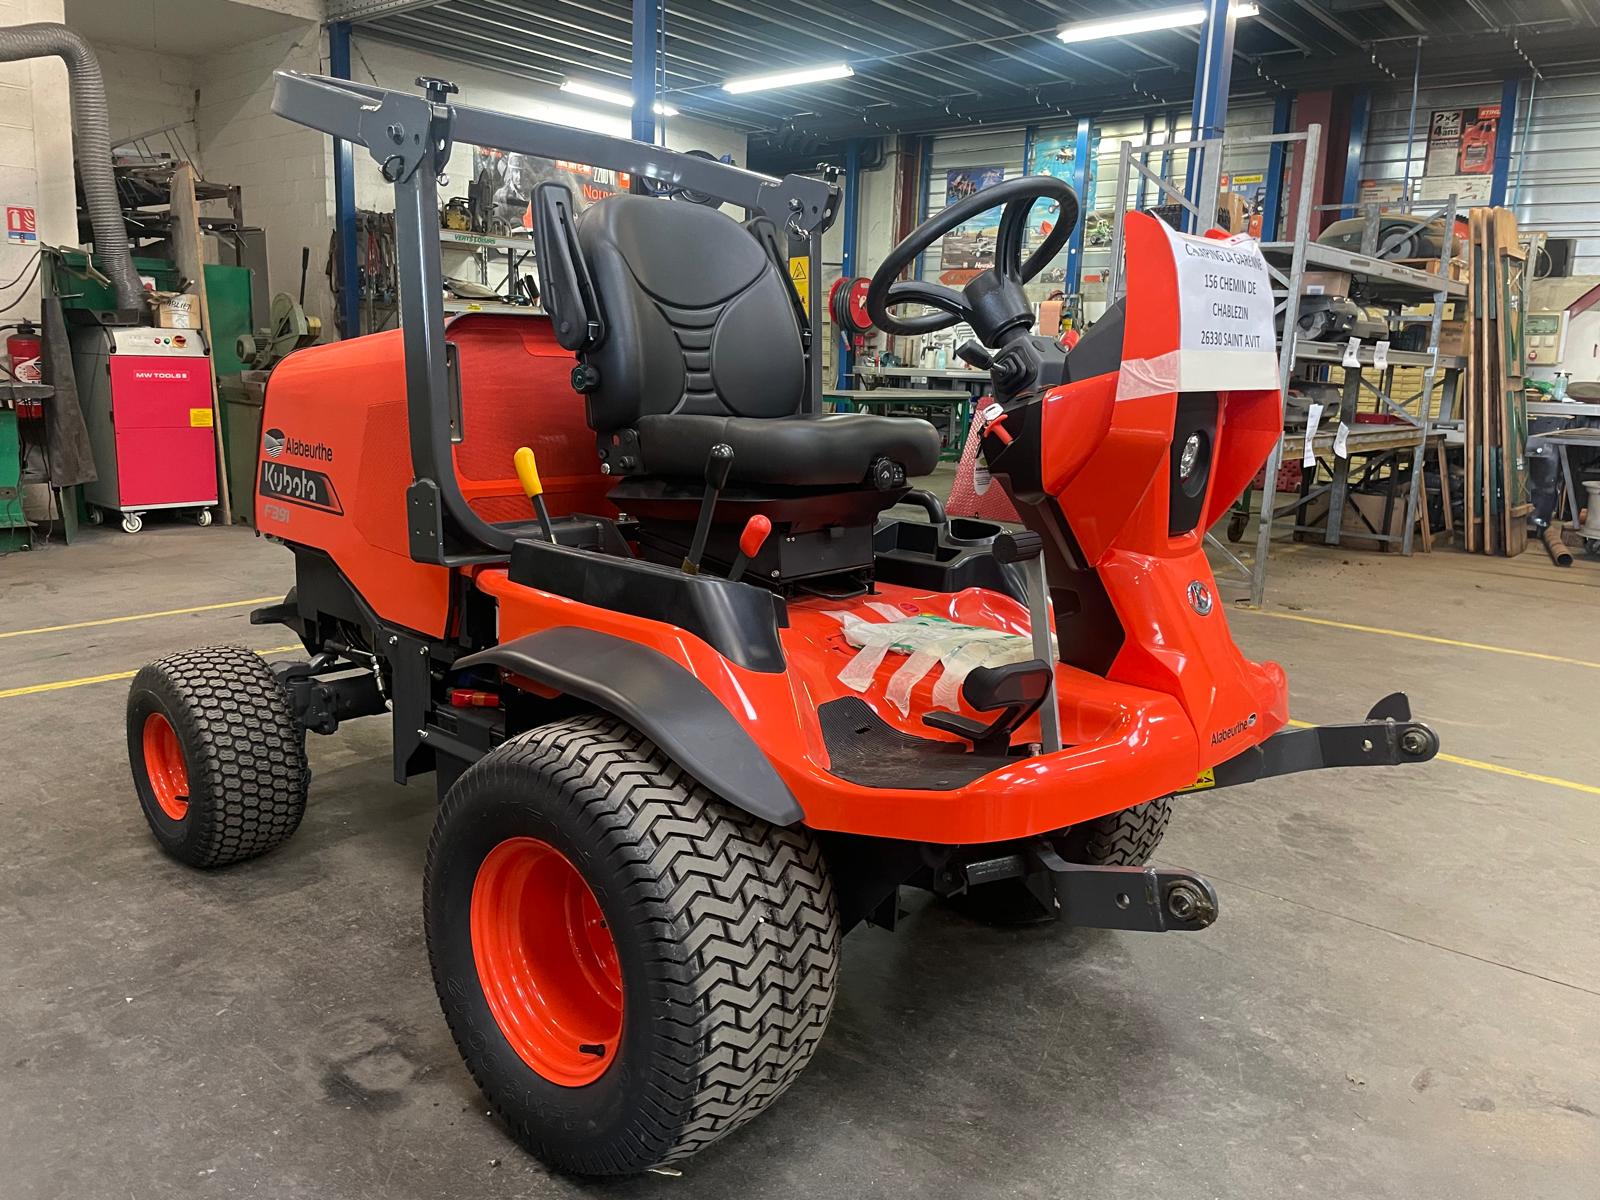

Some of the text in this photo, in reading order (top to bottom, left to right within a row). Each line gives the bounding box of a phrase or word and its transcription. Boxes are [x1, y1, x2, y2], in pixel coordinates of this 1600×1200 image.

[1223, 251, 1234, 264] LA
[1205, 274, 1257, 295] 156 CHEMIN DE
[1212, 302, 1249, 320] CHABLEZIN
[1201, 330, 1261, 348] 26330 SAINT AVIT
[286, 438, 333, 461] Alabeurthe
[264, 462, 316, 501] Kubota
[1211, 720, 1248, 746] Alabeurthe
